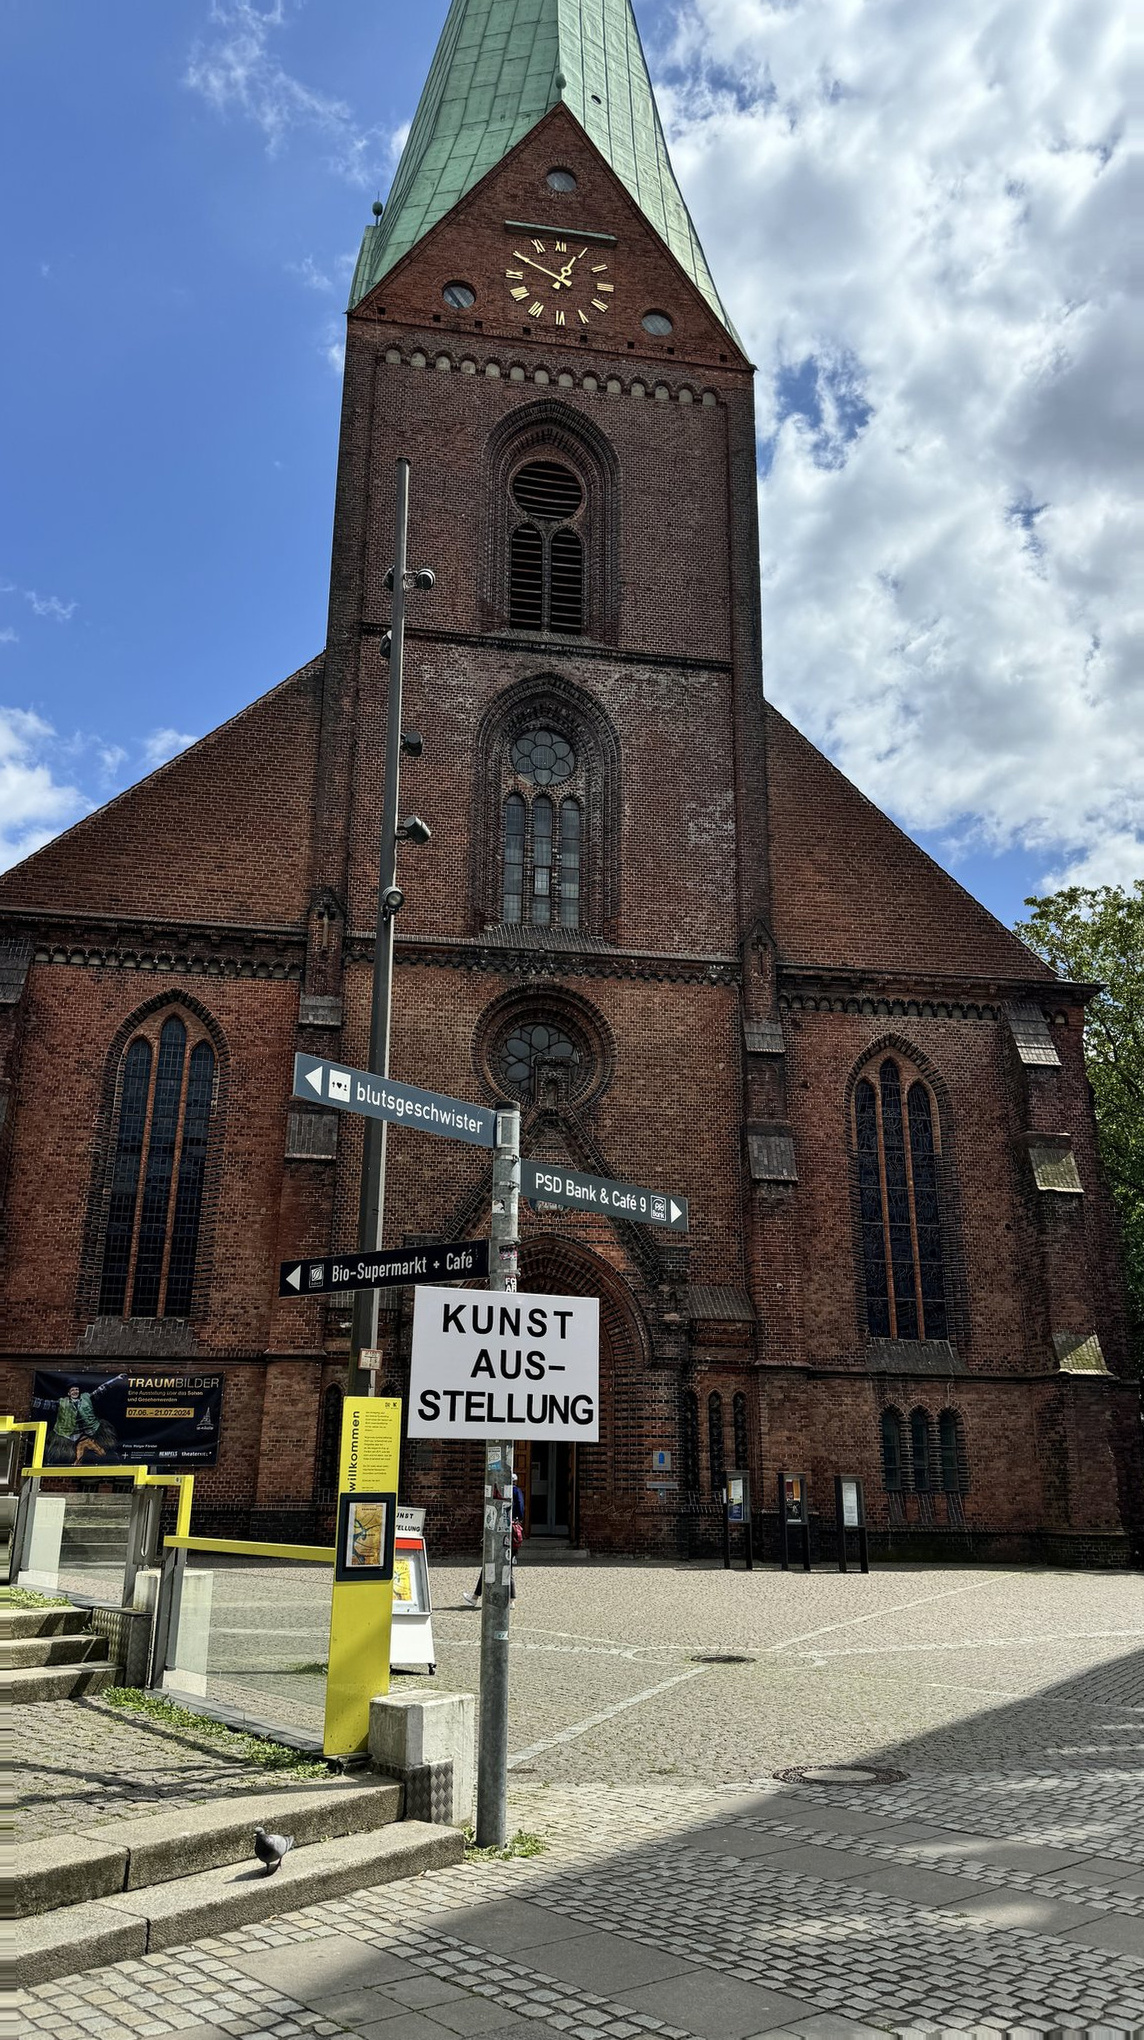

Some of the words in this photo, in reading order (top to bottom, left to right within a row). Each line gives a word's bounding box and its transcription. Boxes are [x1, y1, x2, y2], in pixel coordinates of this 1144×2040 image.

[356, 1081, 484, 1134] blutsgeschwister
[535, 1172, 562, 1194] PSD
[565, 1179, 597, 1202] Bank
[600, 1187, 610, 1205] &
[611, 1190, 637, 1210] Café
[639, 1196, 647, 1213] 9
[331, 1256, 428, 1283] Bio-Supermarkt
[433, 1260, 440, 1269] +
[446, 1249, 473, 1271] Café
[442, 1303, 573, 1340] KUNST
[470, 1348, 566, 1381] AUS-
[128, 1378, 219, 1388] TRAUMBILDER
[417, 1389, 594, 1425] STELLUNG
[347, 1410, 360, 1492] willkommen
